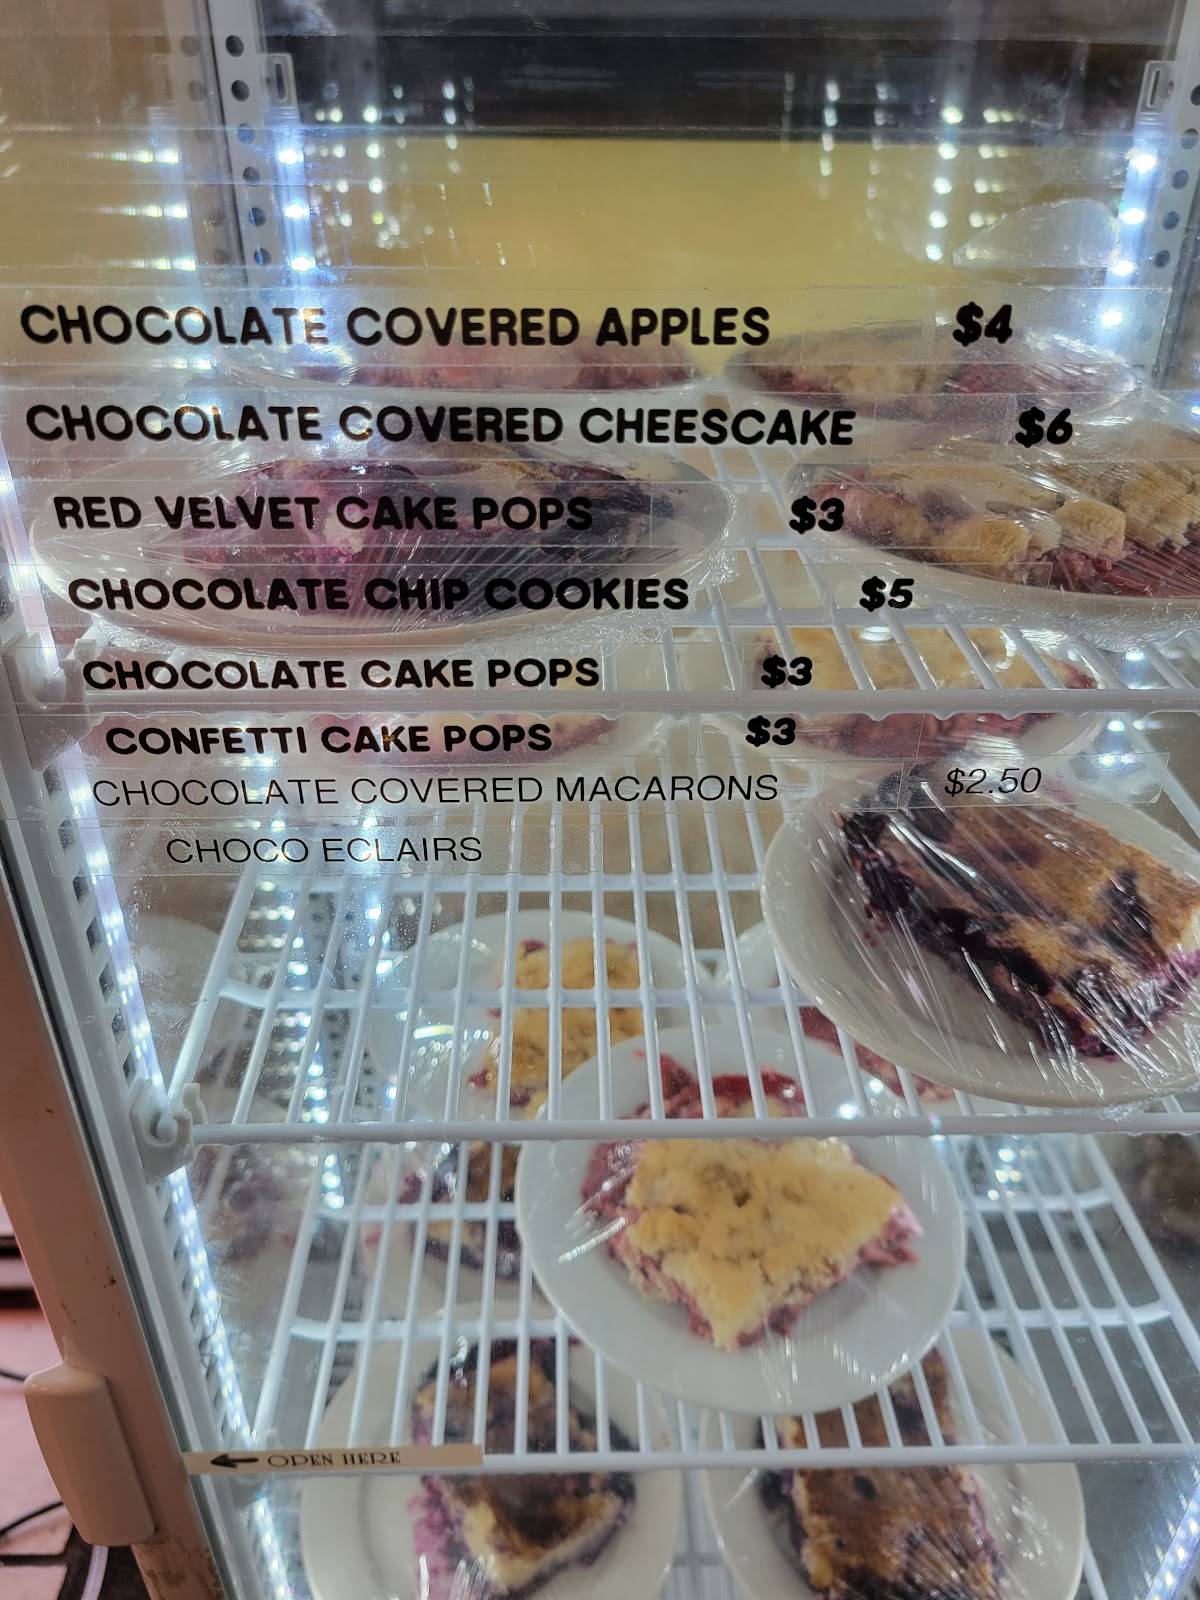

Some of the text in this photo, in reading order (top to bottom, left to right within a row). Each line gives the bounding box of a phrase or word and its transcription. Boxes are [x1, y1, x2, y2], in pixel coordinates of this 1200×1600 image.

[20, 301, 1013, 347] CHOCOLATE COVERED APPLES $4
[25, 404, 1074, 448] CHOCOLATE COVERED CHEESCAKE $6
[53, 496, 845, 534] RED VELVET CAKE POPS $3
[67, 575, 915, 612] CHOCOLATE CHIP COOKIES $5
[82, 655, 813, 690] CHOCOLATE CAKE POPS $3
[105, 716, 797, 755] CONFETTI CAKE POPS $3
[92, 766, 1042, 806] CHOCOLATE COVERED MACARONS $2.50
[166, 836, 482, 864] CHOCO ECLAIRS
[267, 1451, 400, 1467] OPEN HERE
